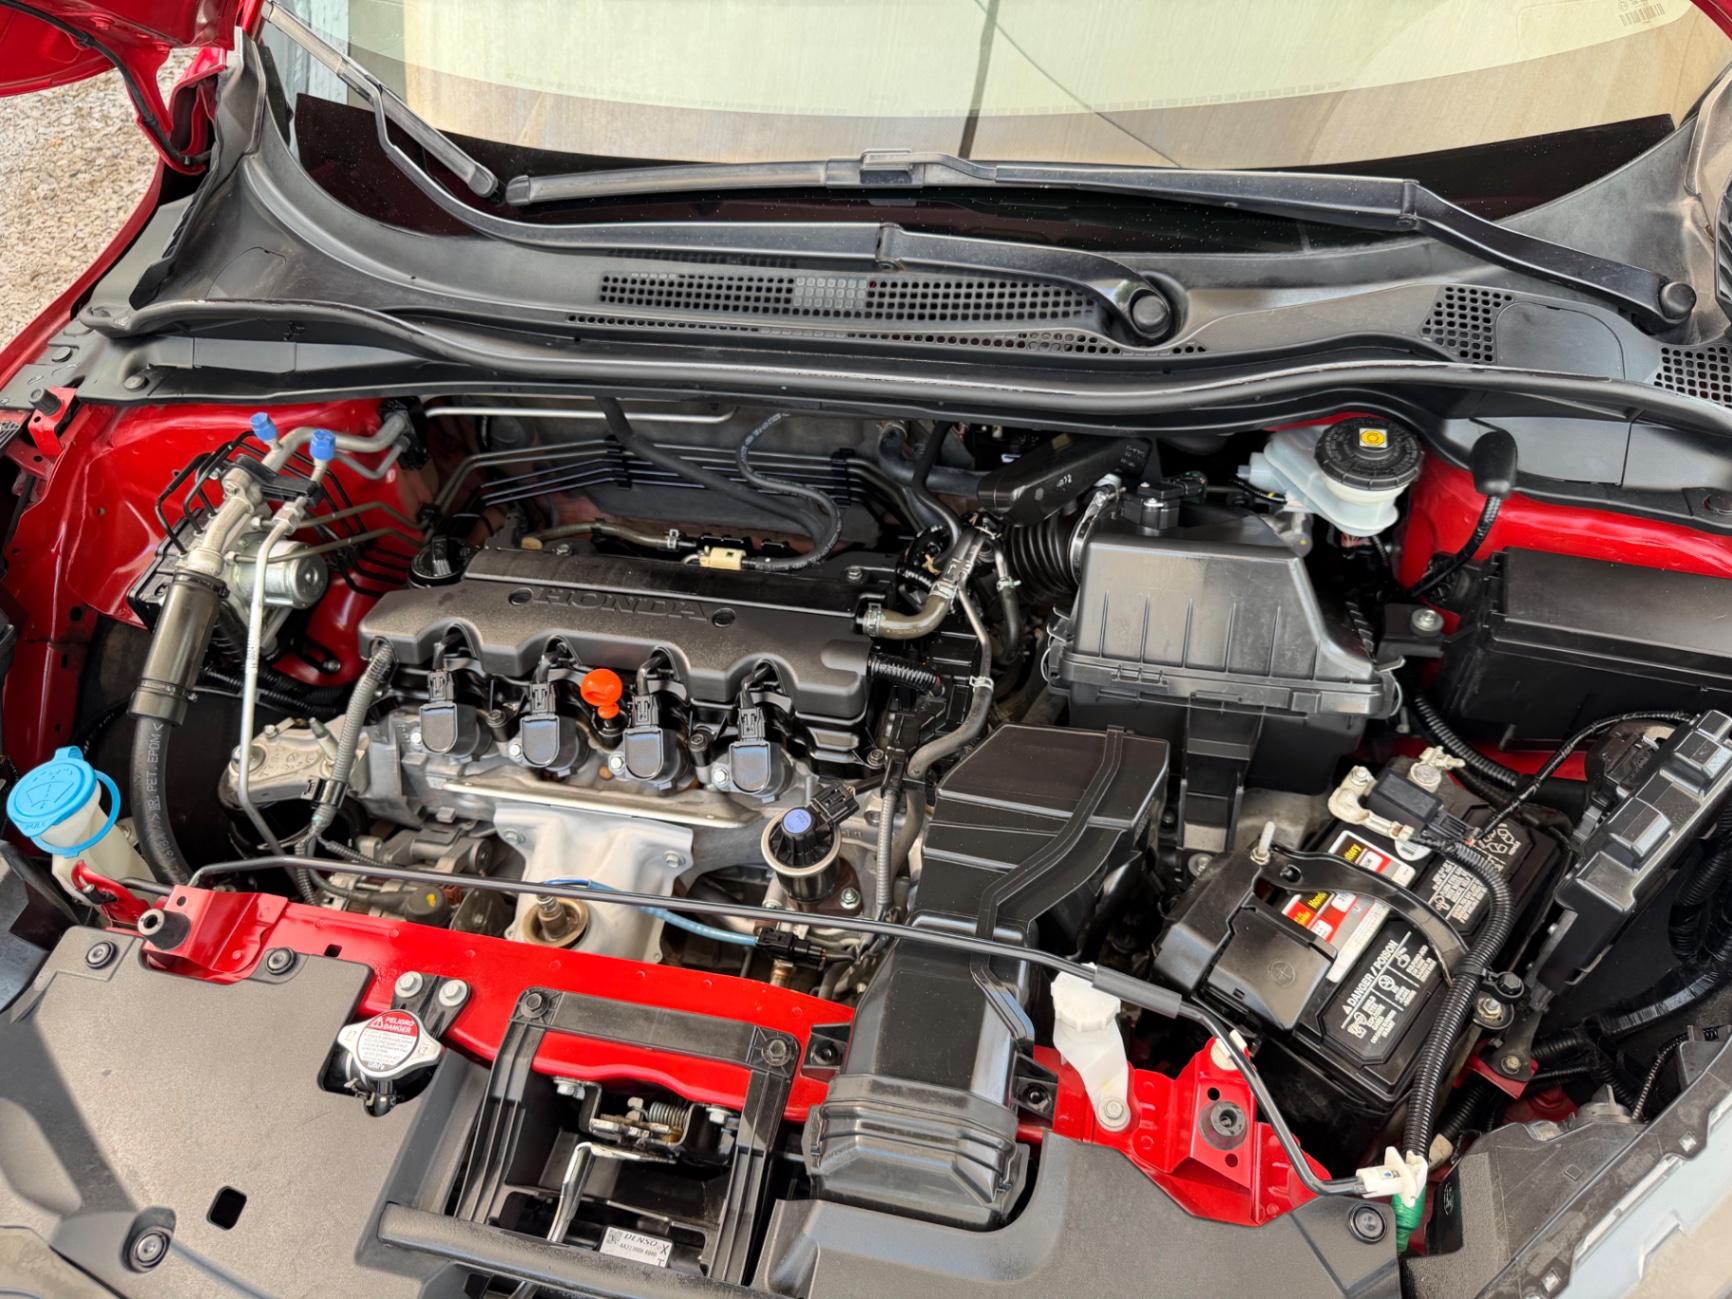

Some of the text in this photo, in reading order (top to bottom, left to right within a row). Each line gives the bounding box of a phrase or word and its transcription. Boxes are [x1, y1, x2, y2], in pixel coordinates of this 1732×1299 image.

[533, 587, 708, 622] HONDA
[383, 1023, 411, 1033] DANGER
[385, 1016, 415, 1027] PELIGRO
[624, 1233, 658, 1247] DENSO
[660, 1243, 670, 1256] X
